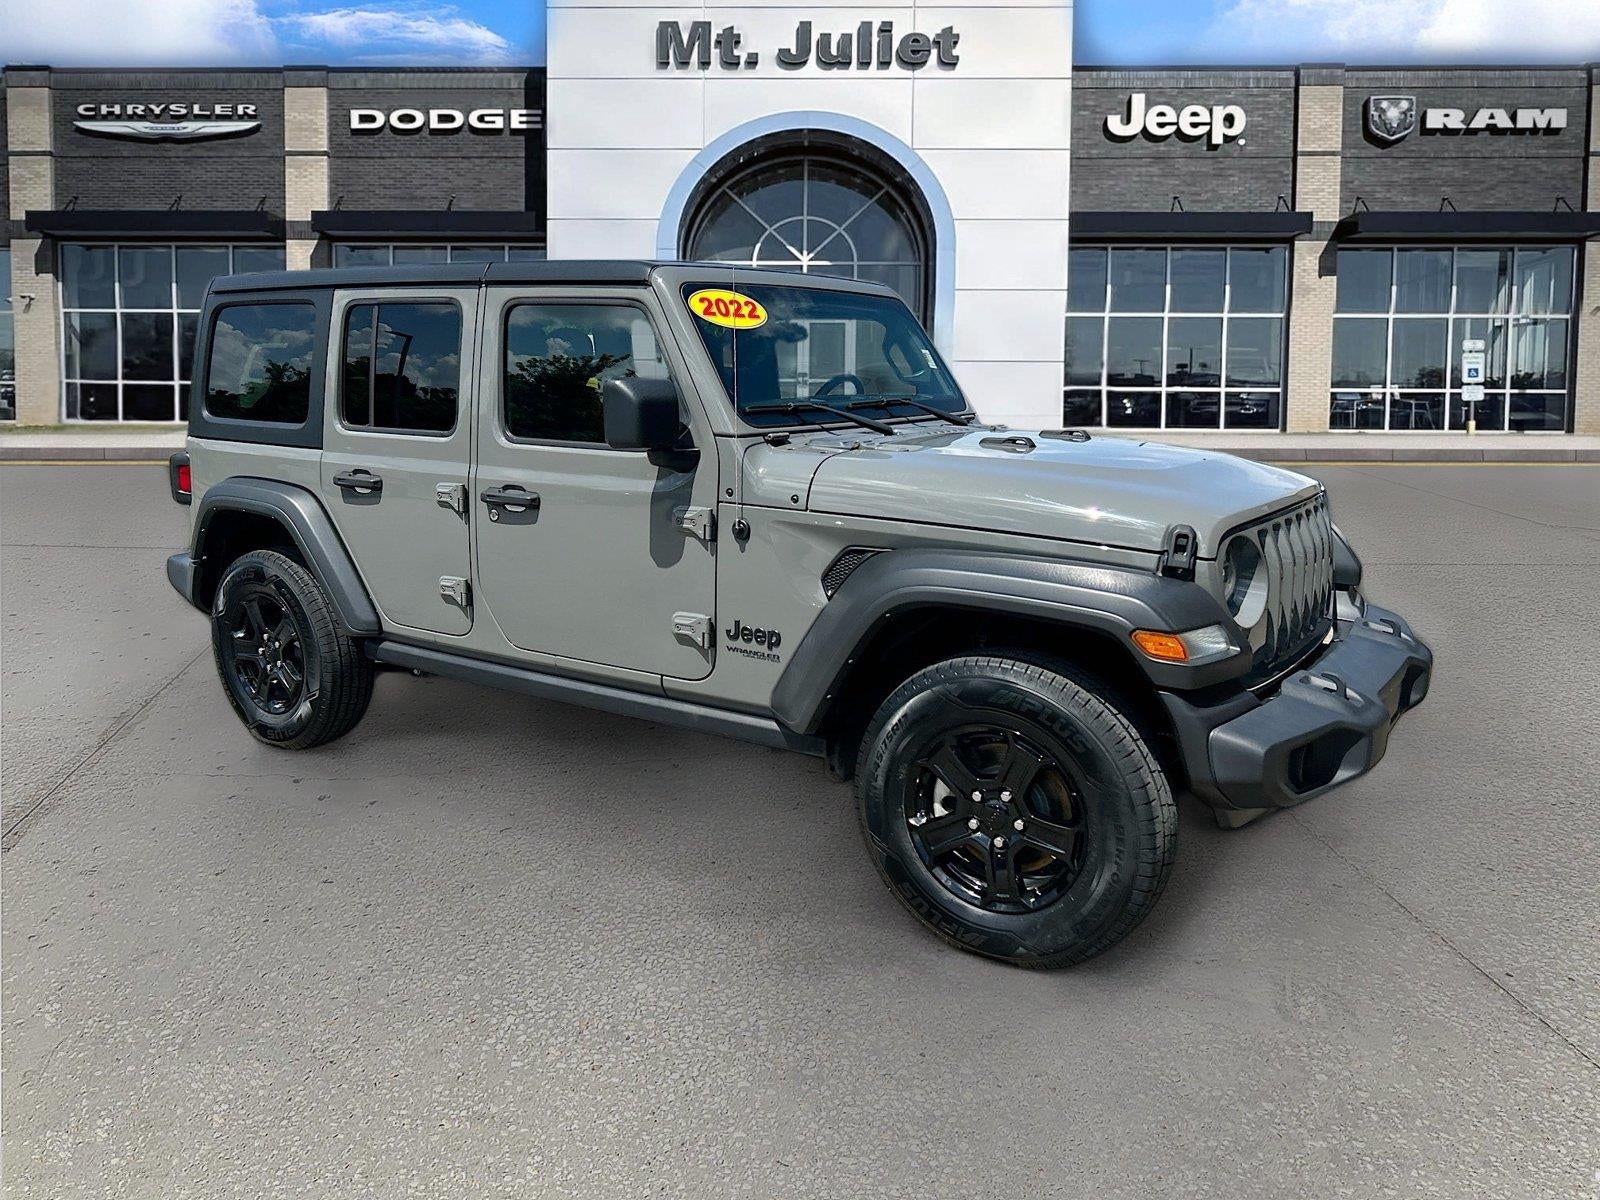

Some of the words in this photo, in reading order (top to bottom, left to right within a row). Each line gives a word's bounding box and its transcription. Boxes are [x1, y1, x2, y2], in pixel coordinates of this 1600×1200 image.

[656, 21, 758, 66] Mt.
[776, 21, 959, 67] Juliet
[76, 103, 257, 117] CHRYSLER
[349, 108, 543, 130] DODGE
[1106, 93, 1246, 145] Jeep
[1425, 107, 1567, 130] RAM
[698, 296, 761, 320] 2022
[725, 619, 781, 652] Jeep
[726, 645, 781, 661] WRANGLER
